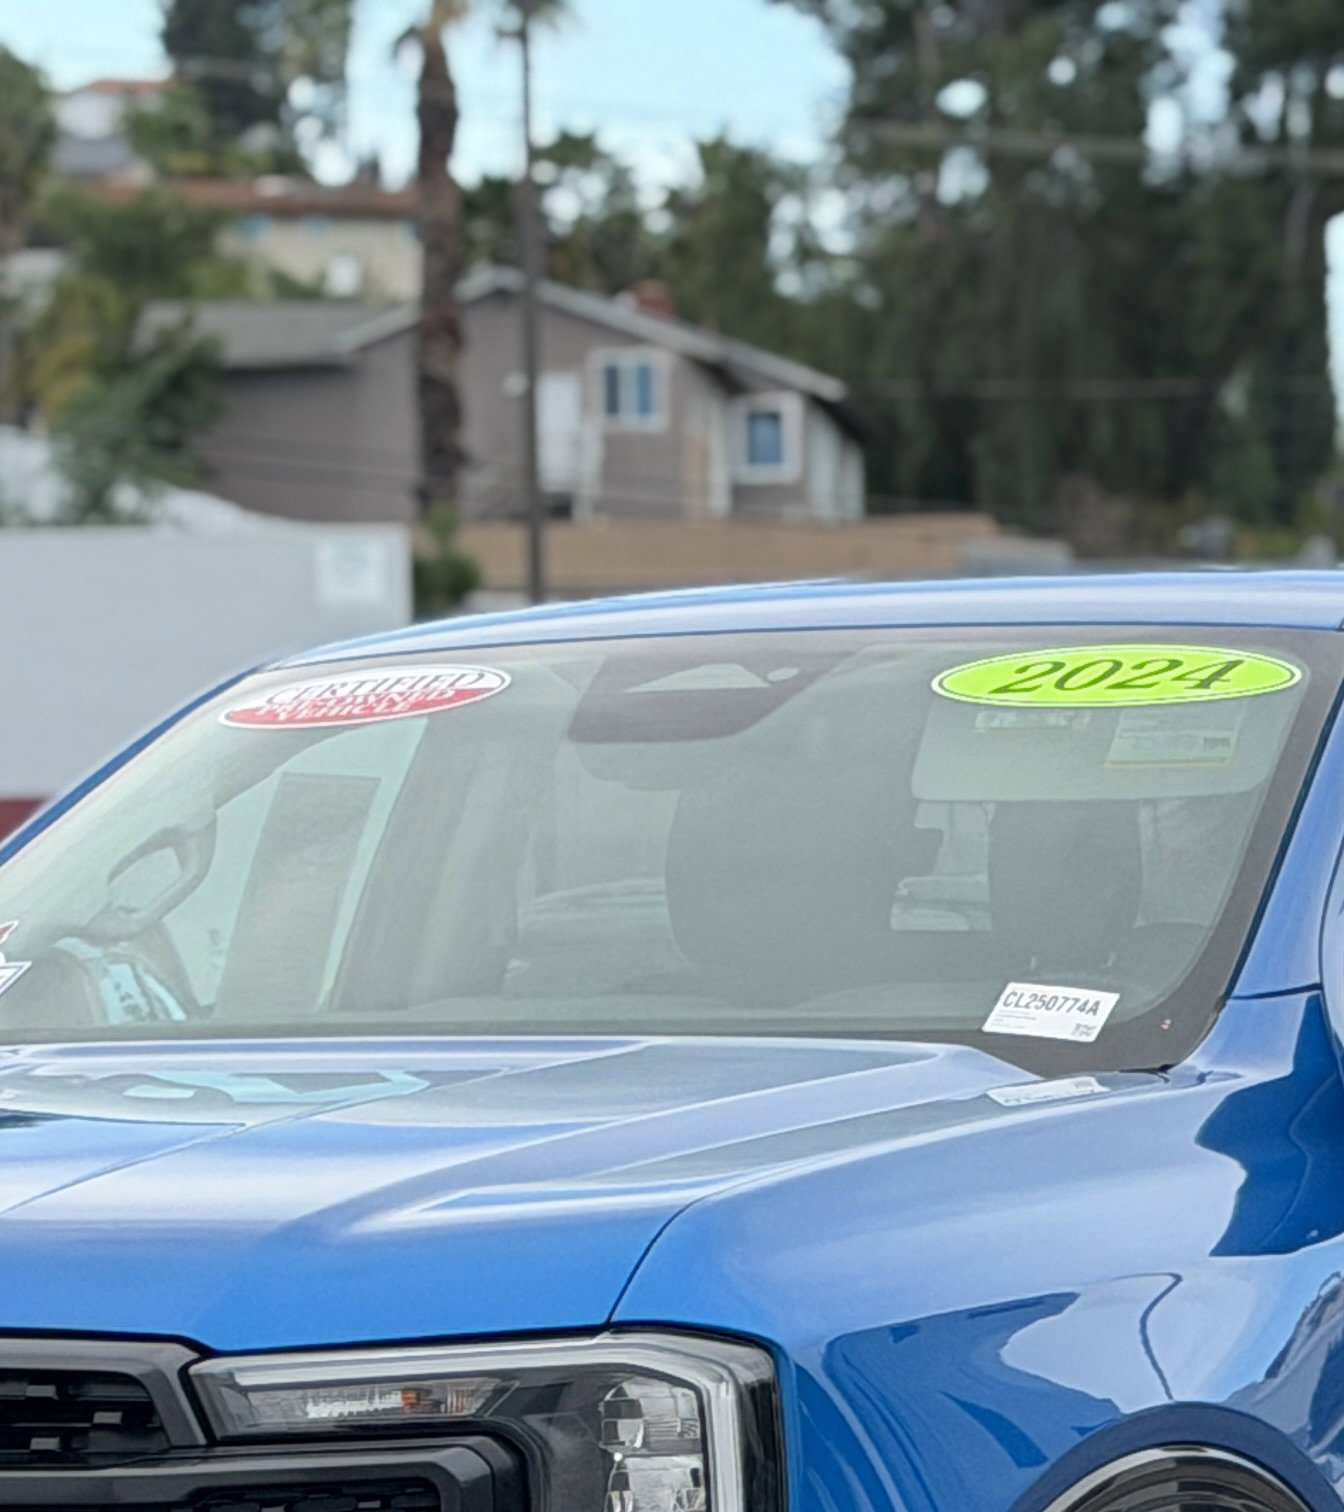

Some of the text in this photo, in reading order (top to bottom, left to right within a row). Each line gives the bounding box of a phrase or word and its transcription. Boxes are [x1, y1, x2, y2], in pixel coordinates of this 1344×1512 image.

[265, 672, 486, 705] CERTIFIED
[988, 656, 1246, 695] 2024
[1002, 990, 1102, 1017] CL250774A
